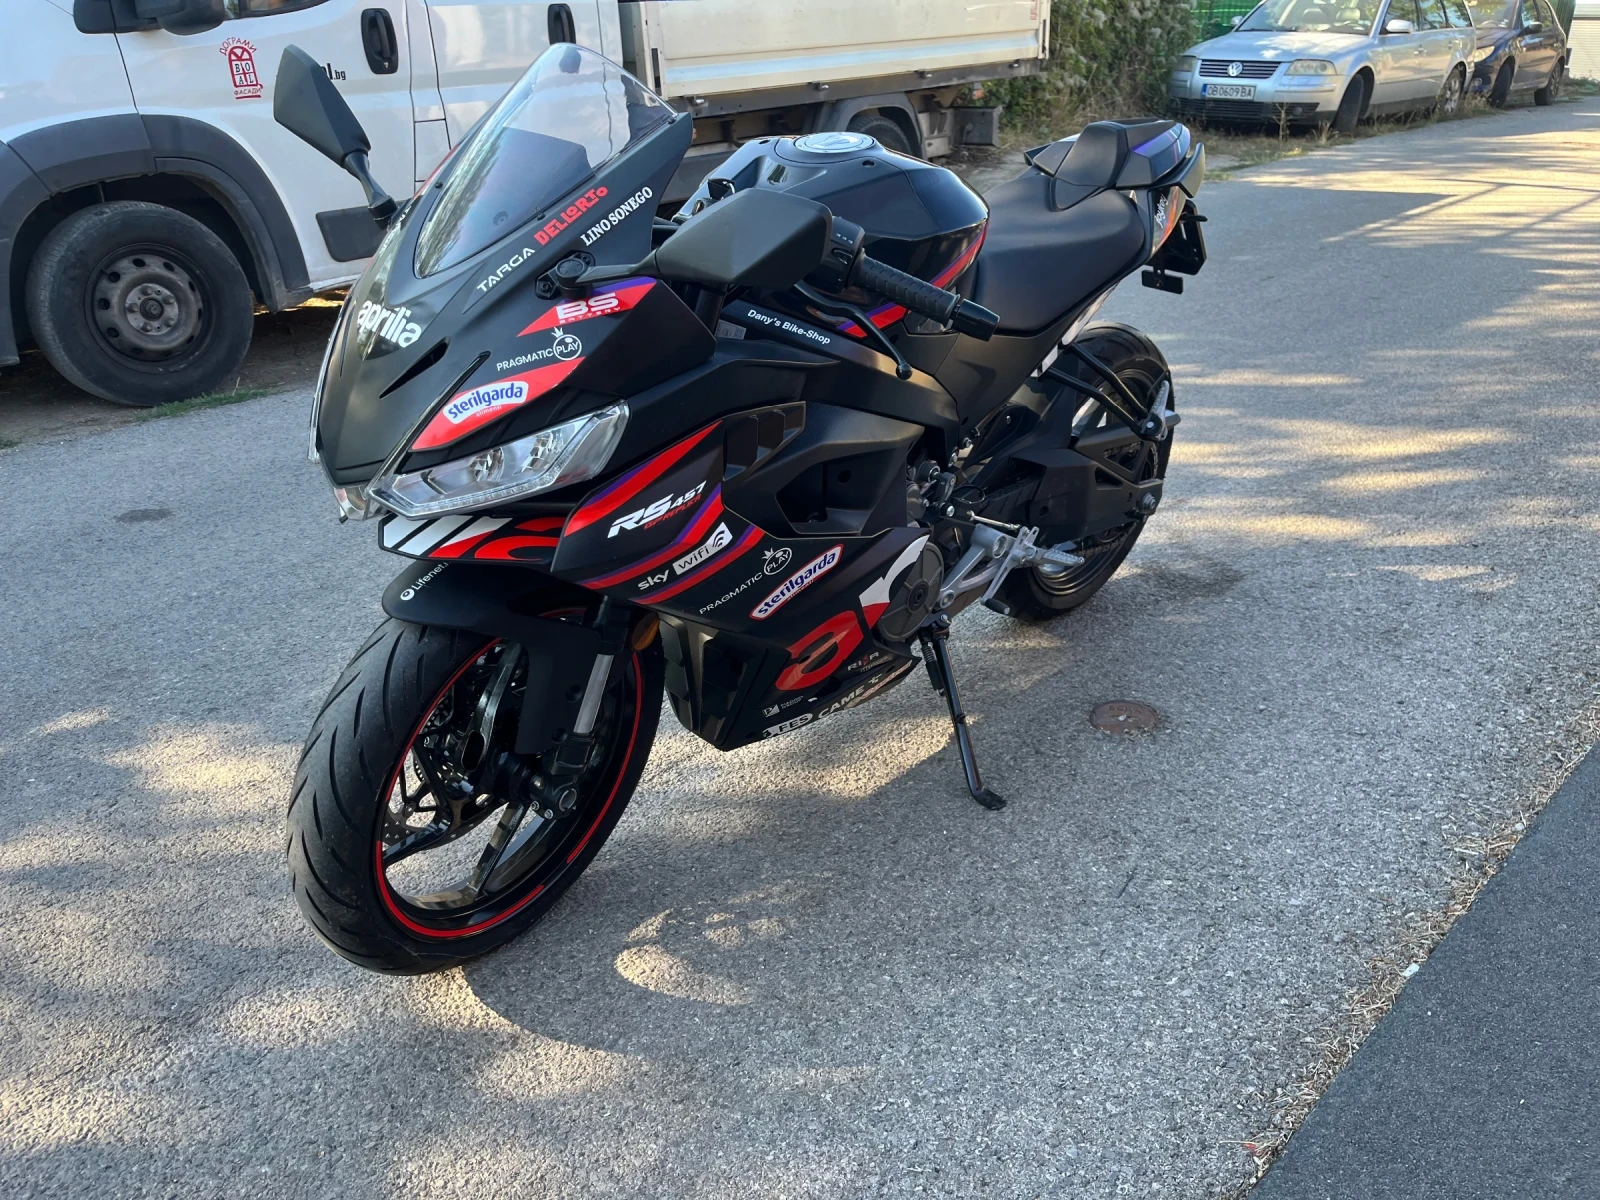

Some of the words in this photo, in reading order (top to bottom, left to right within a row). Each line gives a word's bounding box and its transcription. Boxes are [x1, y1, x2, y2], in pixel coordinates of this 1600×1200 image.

[219, 37, 257, 56] ДОГРАМИ
[234, 87, 262, 96] ФАСАДИ
[580, 219, 611, 247] LINO
[609, 186, 653, 226] SONEGO
[476, 247, 535, 292] TARGA
[357, 300, 422, 348] aprilia
[555, 292, 619, 320] BS
[747, 308, 782, 328] Dany's
[782, 320, 831, 345] Bike-Shop
[496, 348, 554, 372] PRAGMATIC
[556, 341, 579, 355] PLAY
[448, 382, 523, 419] sterilgarda
[607, 493, 675, 539] RS
[670, 480, 707, 509] 457
[662, 493, 702, 521] REPLICA
[637, 569, 670, 590] sky
[678, 544, 710, 570] wifi
[700, 572, 763, 615] PRAGMATIC
[766, 551, 789, 572] PLAY
[758, 552, 836, 615] sterilgarda
